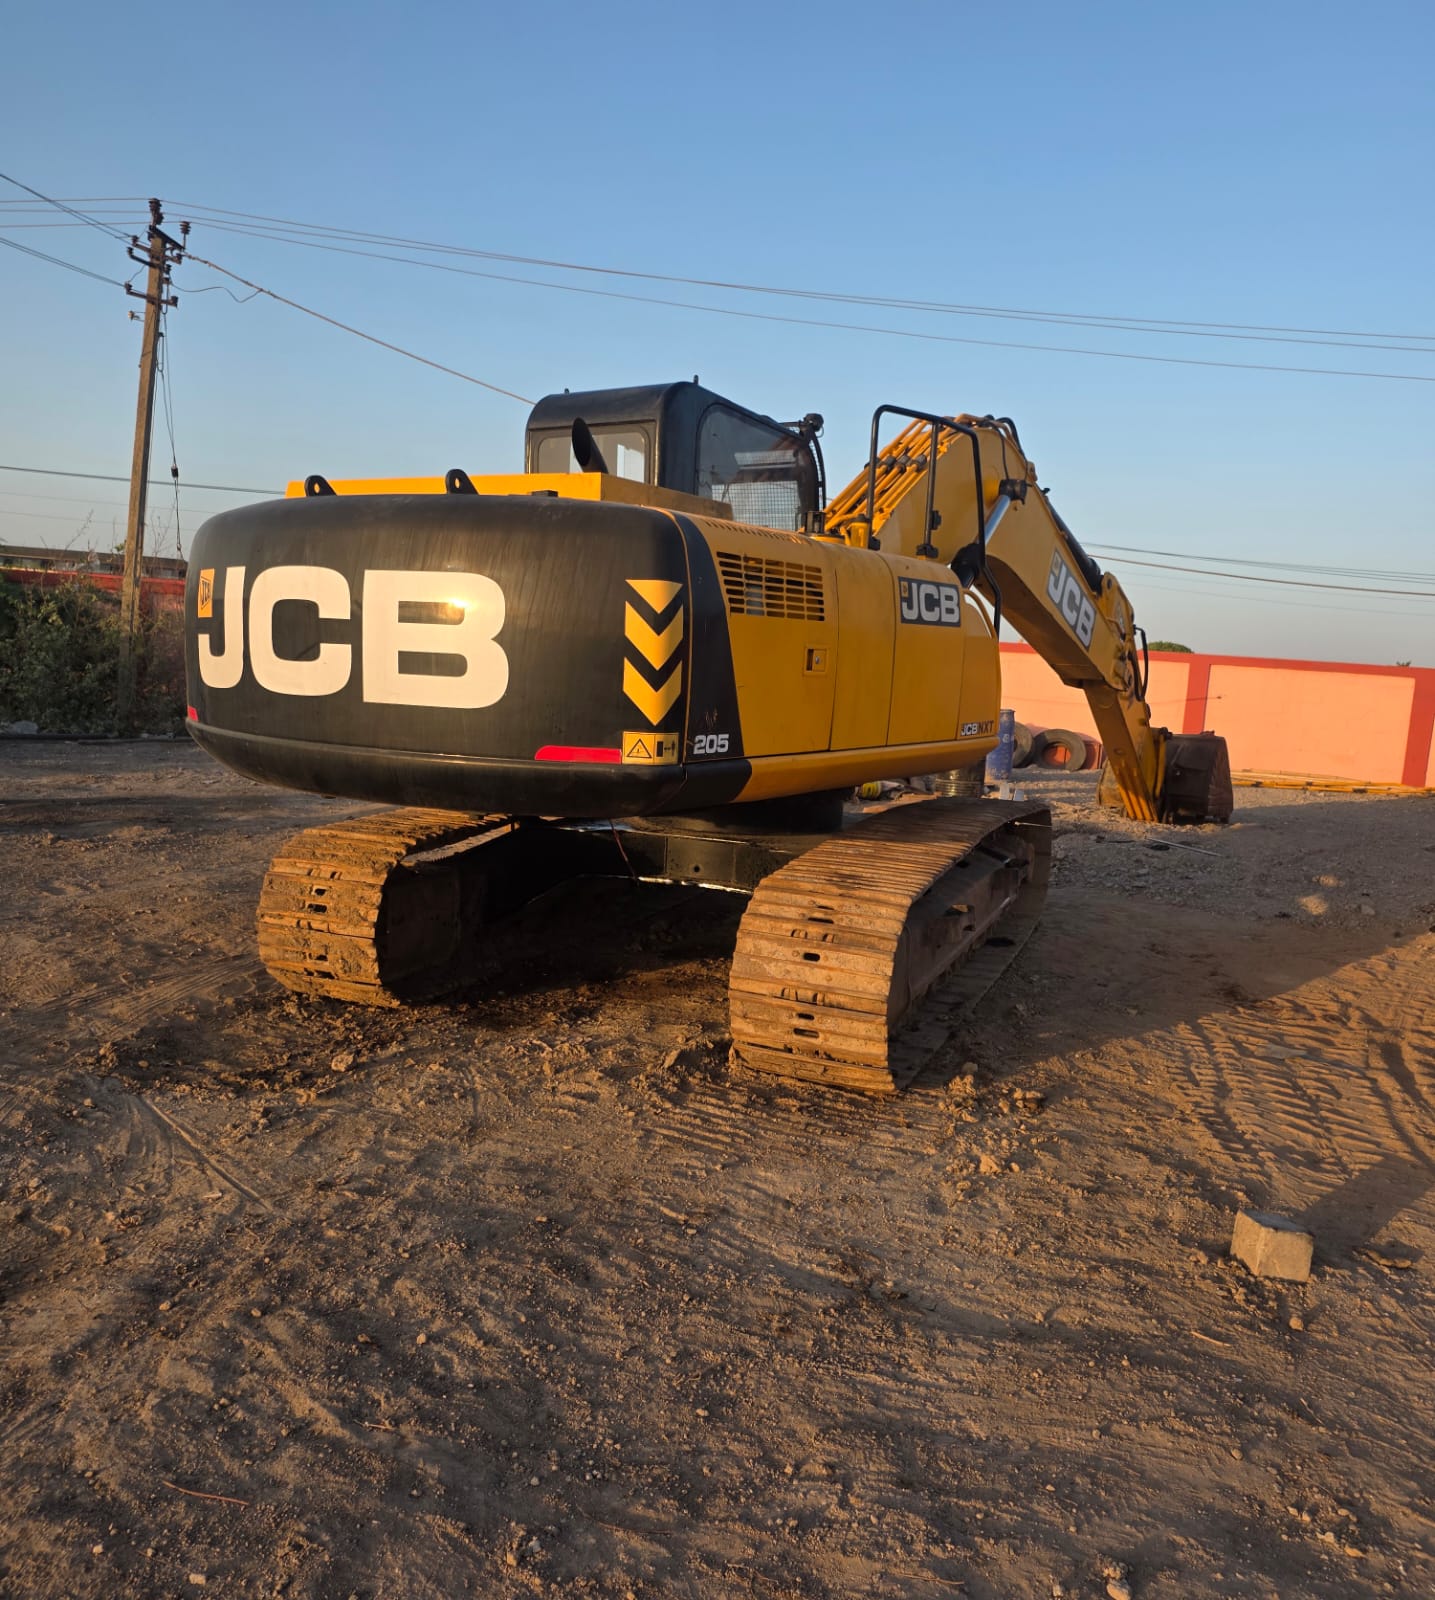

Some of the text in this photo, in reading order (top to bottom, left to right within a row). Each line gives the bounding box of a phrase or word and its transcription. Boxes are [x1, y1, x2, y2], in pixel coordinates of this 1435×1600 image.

[902, 582, 960, 623] JCB
[1048, 562, 1096, 648] JCB
[198, 565, 509, 709] JCB
[693, 734, 729, 755] 205
